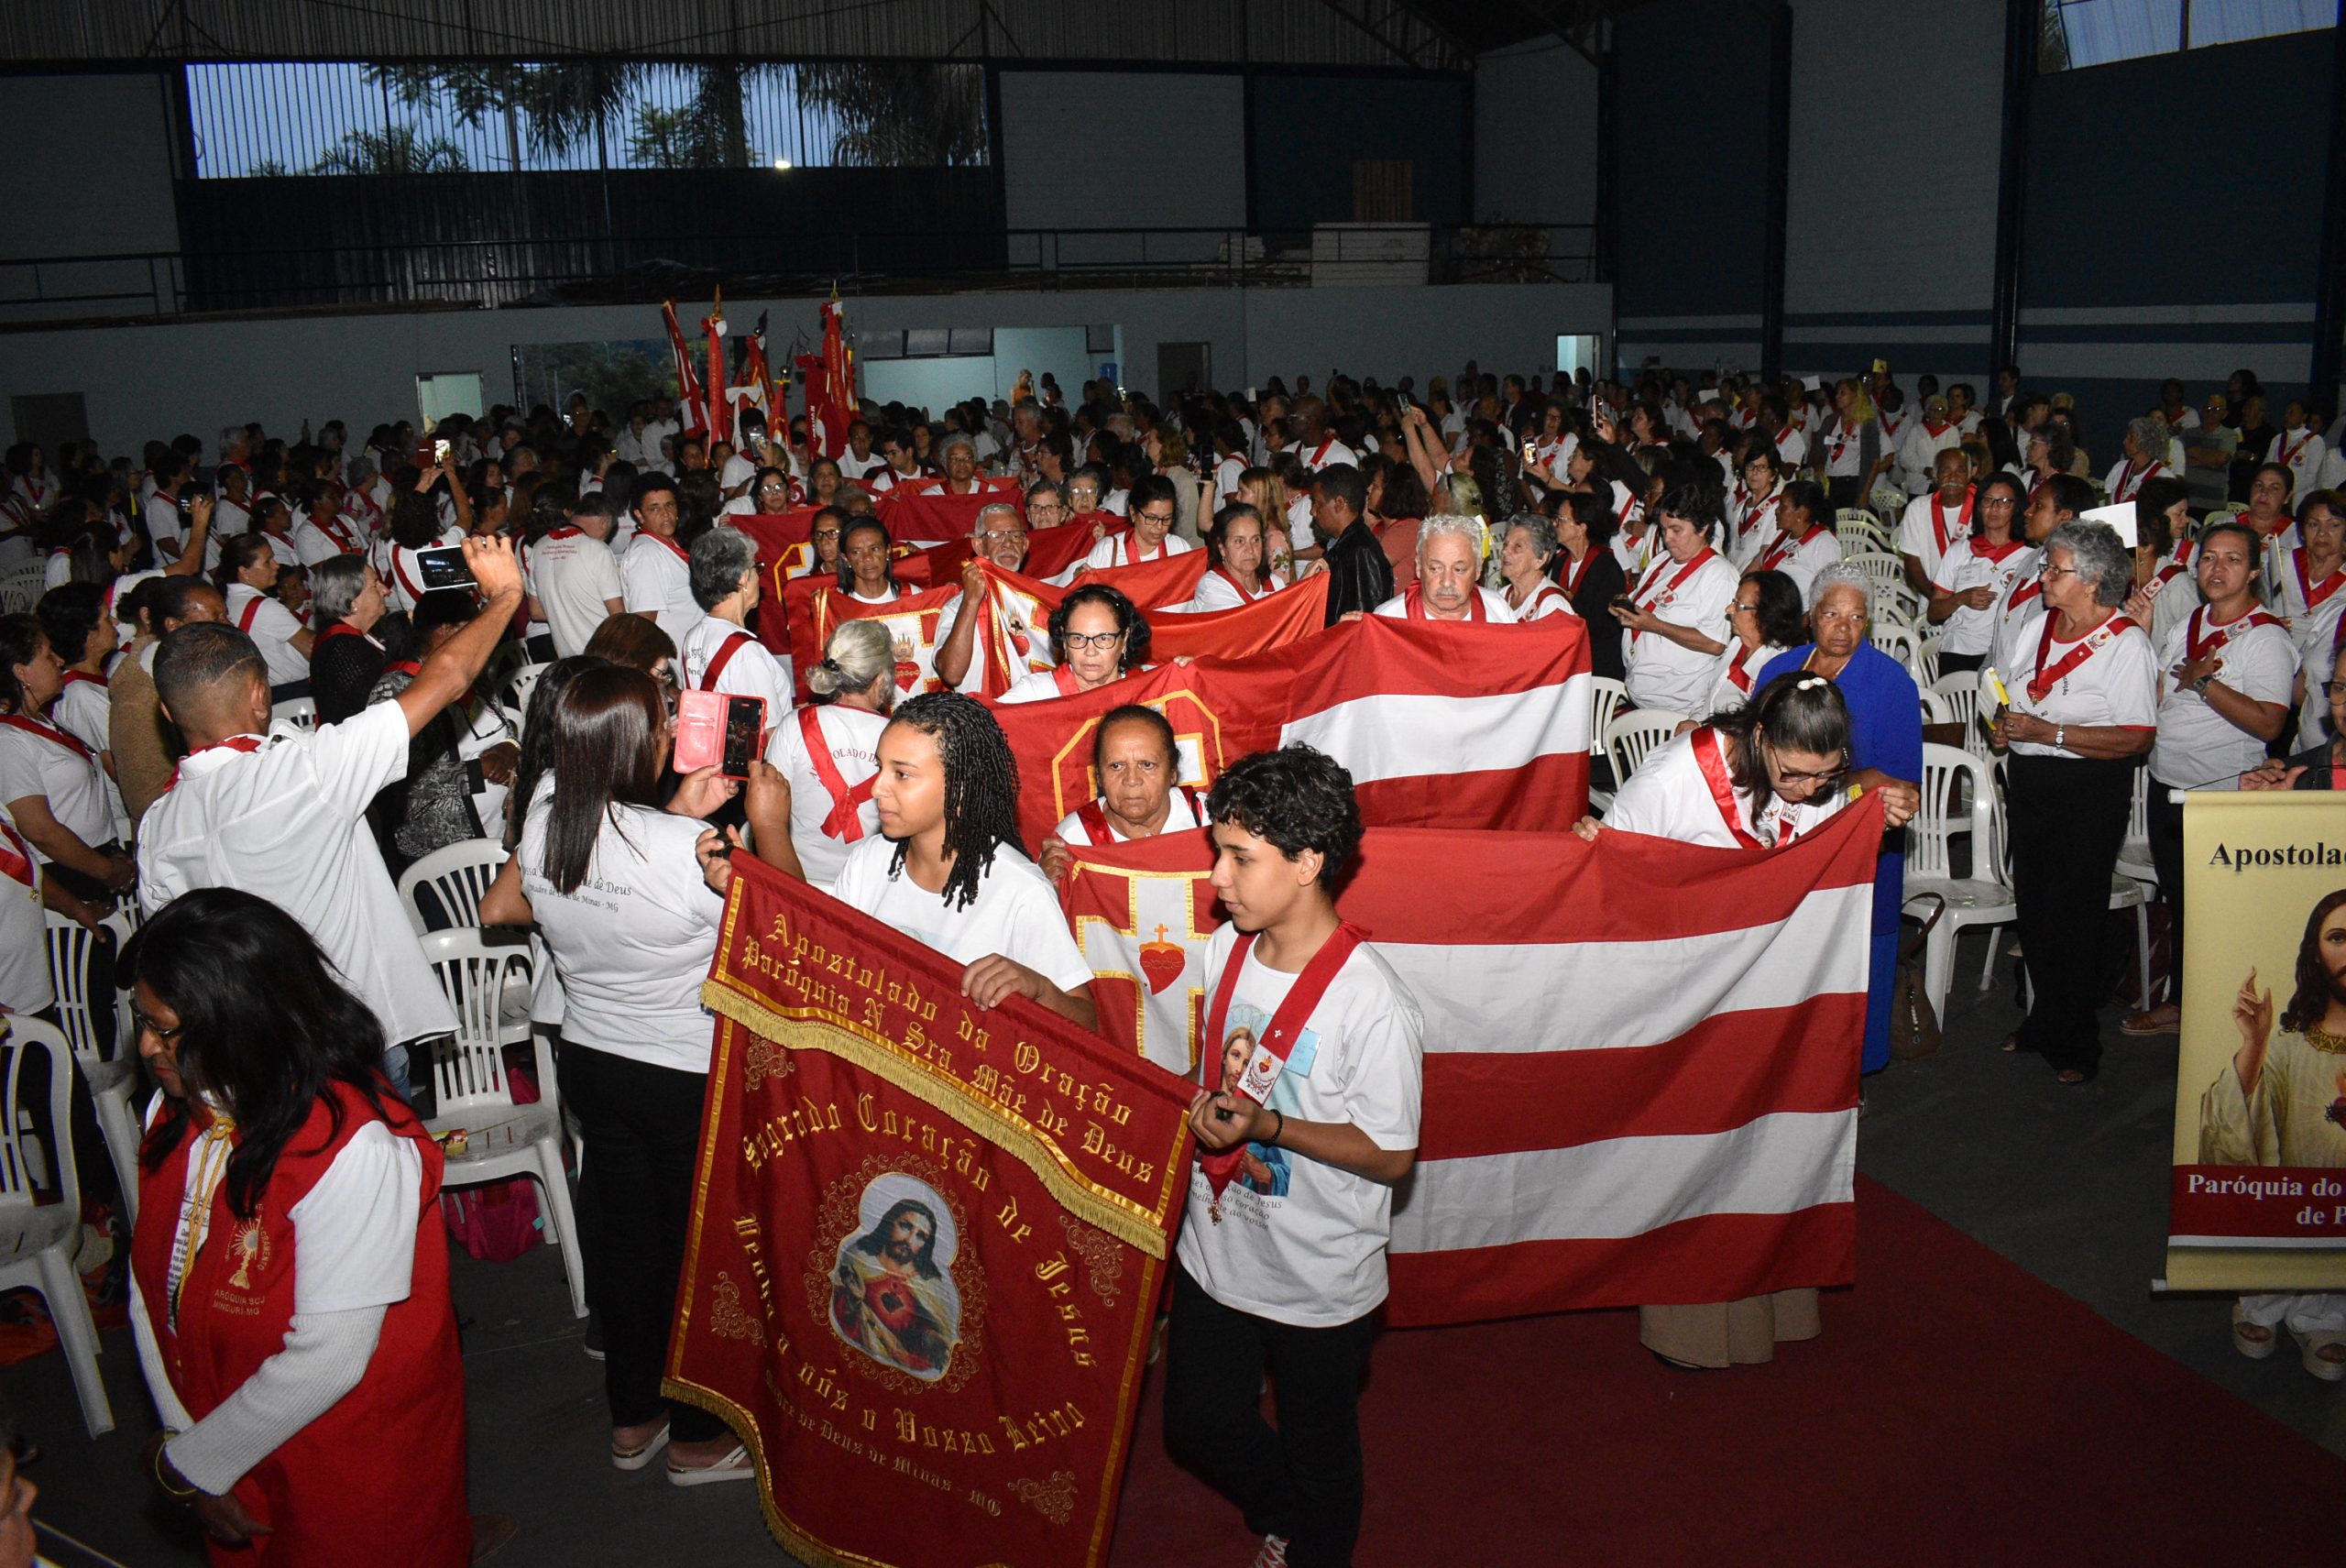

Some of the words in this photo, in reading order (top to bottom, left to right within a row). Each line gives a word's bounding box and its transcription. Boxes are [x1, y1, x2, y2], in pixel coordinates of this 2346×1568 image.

[2209, 842, 2346, 872] Apostola
[594, 879, 604, 891] de
[606, 881, 632, 896] Deus
[581, 894, 601, 907] Minas
[606, 902, 619, 913] MG
[766, 914, 937, 1021] Apostolado
[956, 1009, 990, 1051] da
[1014, 1041, 1132, 1125] Oração
[742, 935, 850, 1015] Paróquia
[901, 1021, 957, 1075] Sra.
[970, 1064, 1026, 1113] Mãe
[1036, 1099, 1069, 1136] de
[1080, 1120, 1154, 1183] Deus
[1244, 1190, 1255, 1201] de
[1255, 1196, 1283, 1211] Jesus
[2187, 1173, 2304, 1201] Paróquia
[2311, 1177, 2342, 1197] do
[1229, 1208, 1242, 1218] ao
[1235, 1199, 1270, 1220] coração
[2296, 1206, 2326, 1225] de
[743, 1095, 842, 1174] Sagrado
[858, 1091, 991, 1191] Coração
[995, 1195, 1033, 1244] de
[1035, 1250, 1099, 1368] Jesus
[796, 1361, 850, 1411] nós
[861, 1408, 876, 1431] o
[893, 1407, 996, 1456] Vosso
[998, 1400, 1086, 1453] Reino
[820, 1419, 862, 1454] Deus
[869, 1445, 887, 1466] de
[892, 1456, 952, 1492] Minas
[968, 1489, 1002, 1517] MG
